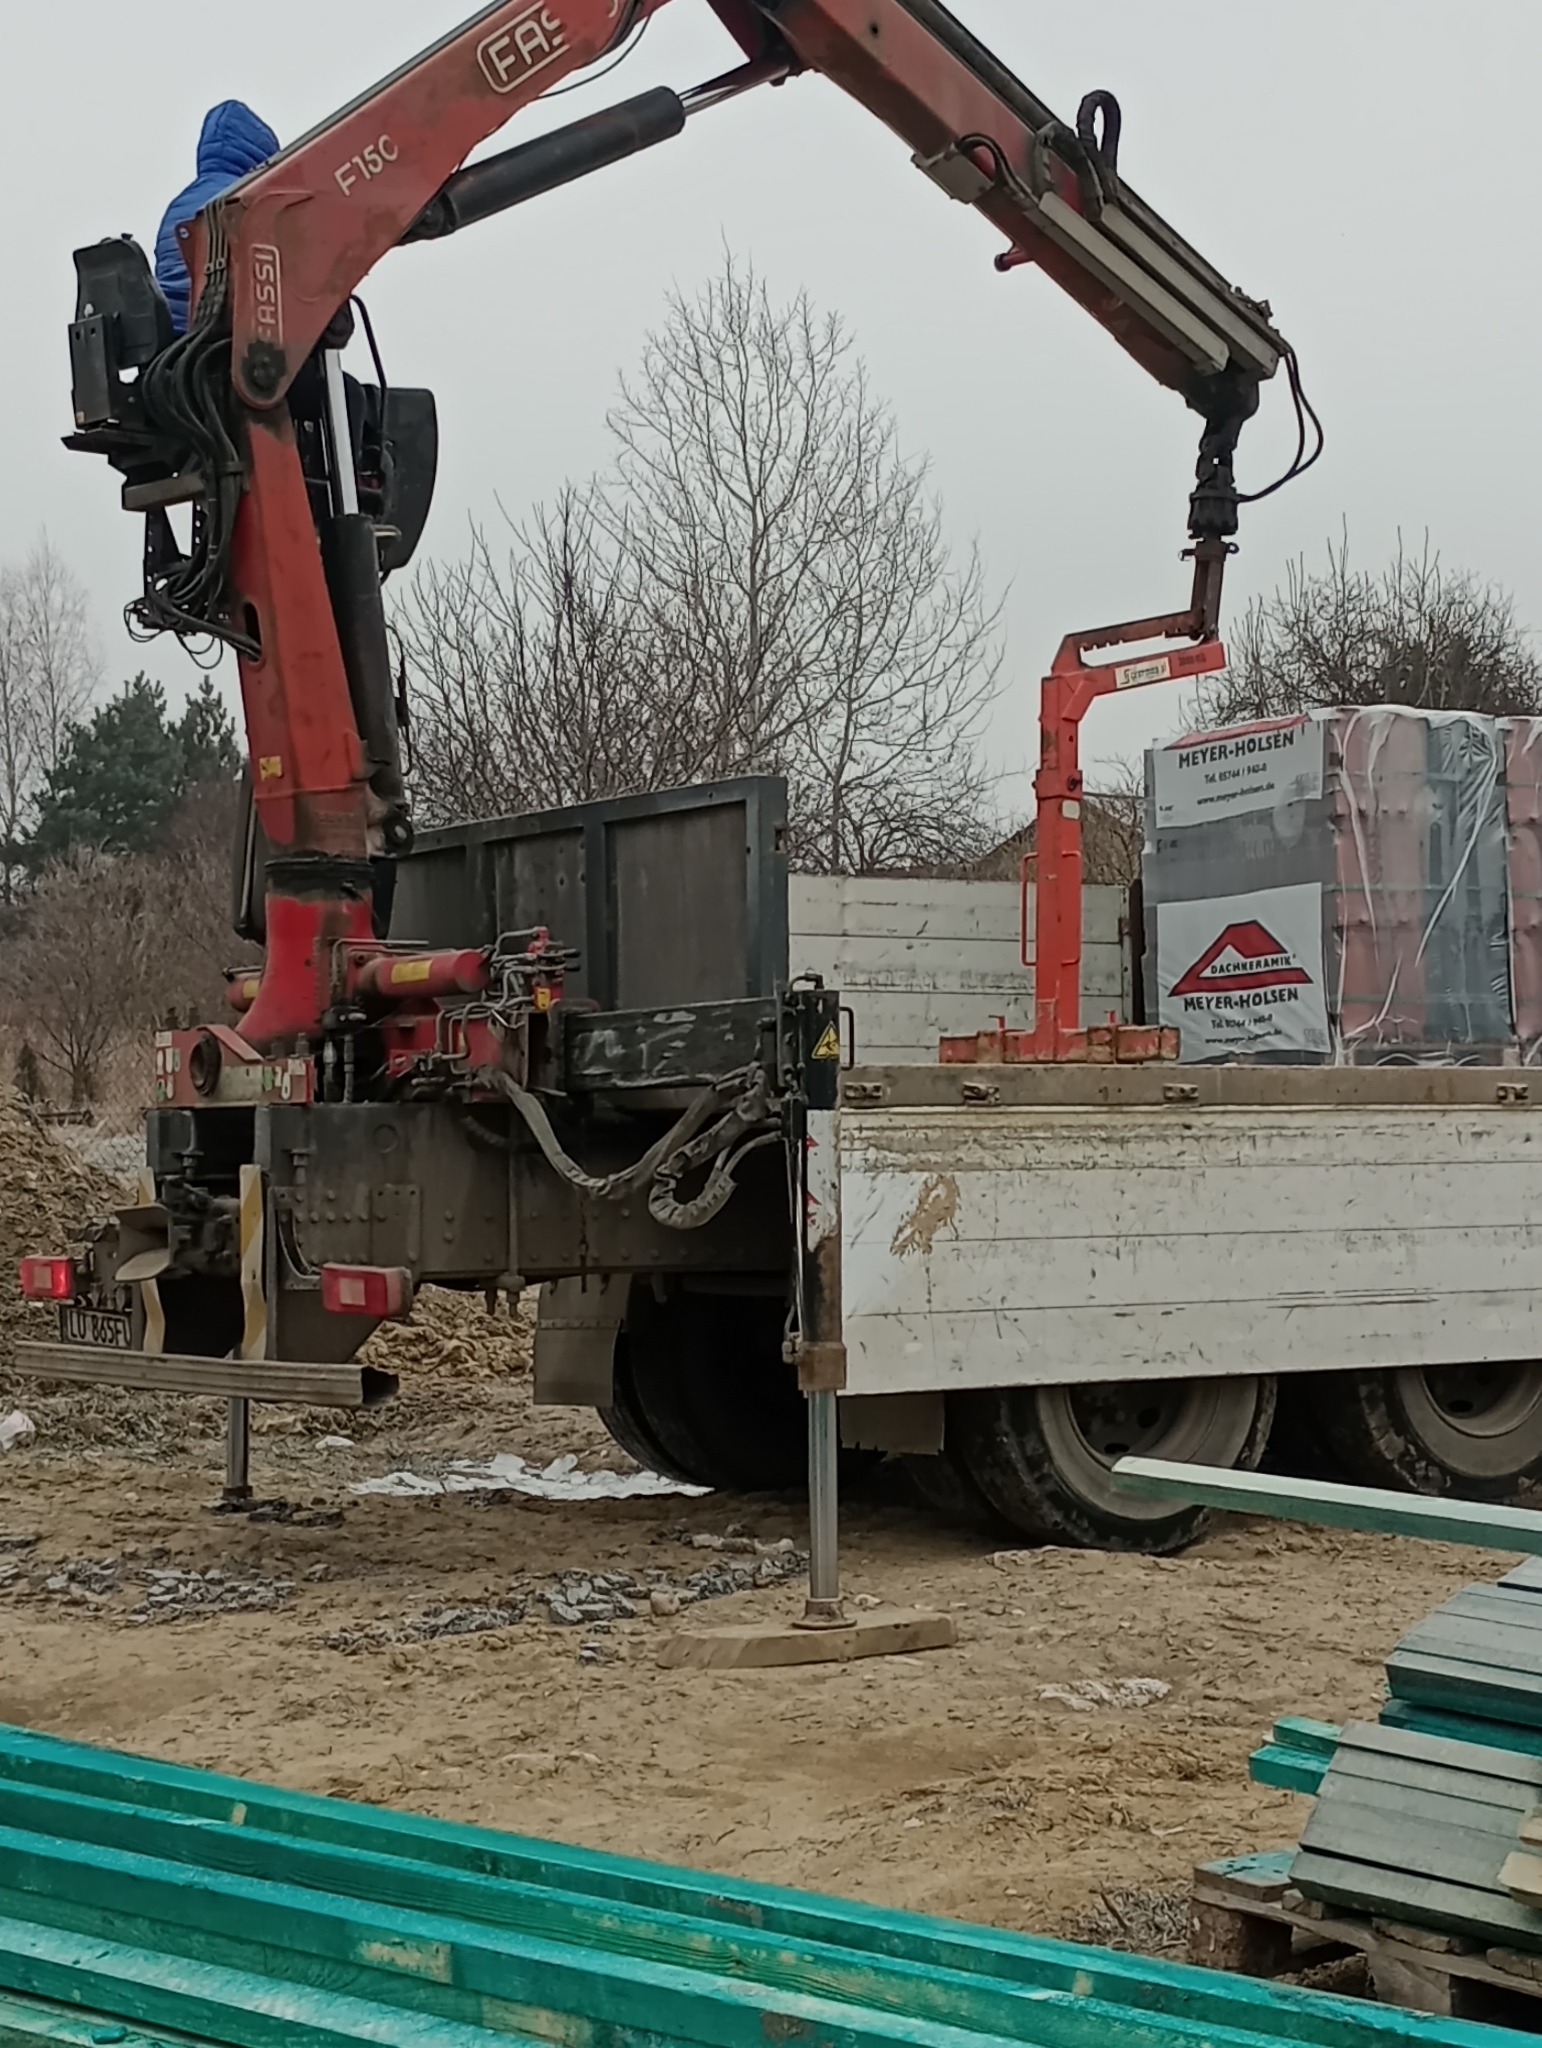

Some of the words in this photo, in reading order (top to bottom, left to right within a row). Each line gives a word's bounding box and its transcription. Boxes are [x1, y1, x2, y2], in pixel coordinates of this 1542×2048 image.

[334, 134, 398, 196] F15C
[1178, 731, 1295, 769] MEYER-HOLSEN
[1184, 987, 1299, 1012] MEYER-HOLSEN
